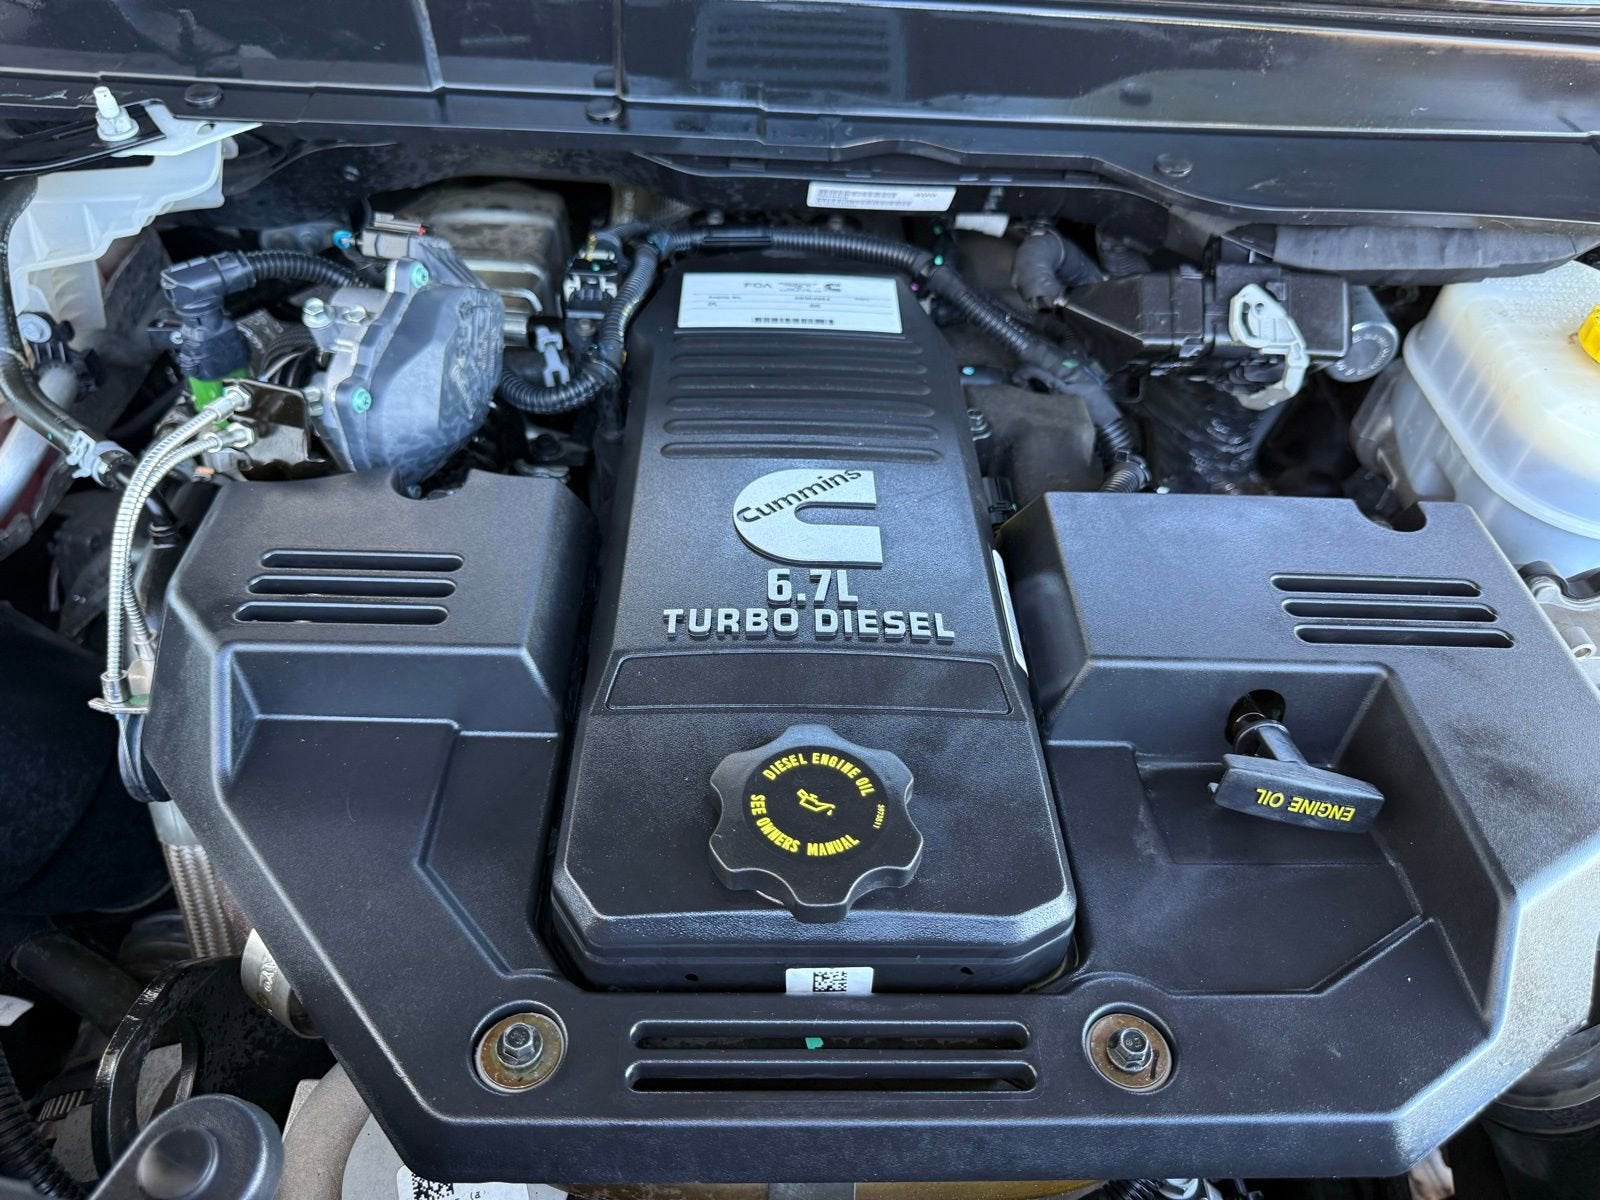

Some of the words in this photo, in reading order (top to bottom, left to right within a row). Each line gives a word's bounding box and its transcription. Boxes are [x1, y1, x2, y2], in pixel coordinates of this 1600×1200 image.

[736, 469, 862, 523] Cummins
[767, 568, 858, 607] 6.7L
[663, 608, 799, 638] TURBO
[814, 608, 955, 643] DIESEL
[762, 753, 808, 781] DIESEL
[811, 752, 862, 779] ENGINE
[855, 777, 875, 797] OIL
[750, 794, 767, 816] SEE
[1256, 788, 1285, 808] OIL
[1287, 796, 1356, 822] ENGINE
[756, 817, 801, 853] OWNERS
[807, 834, 861, 857] MANUAL
